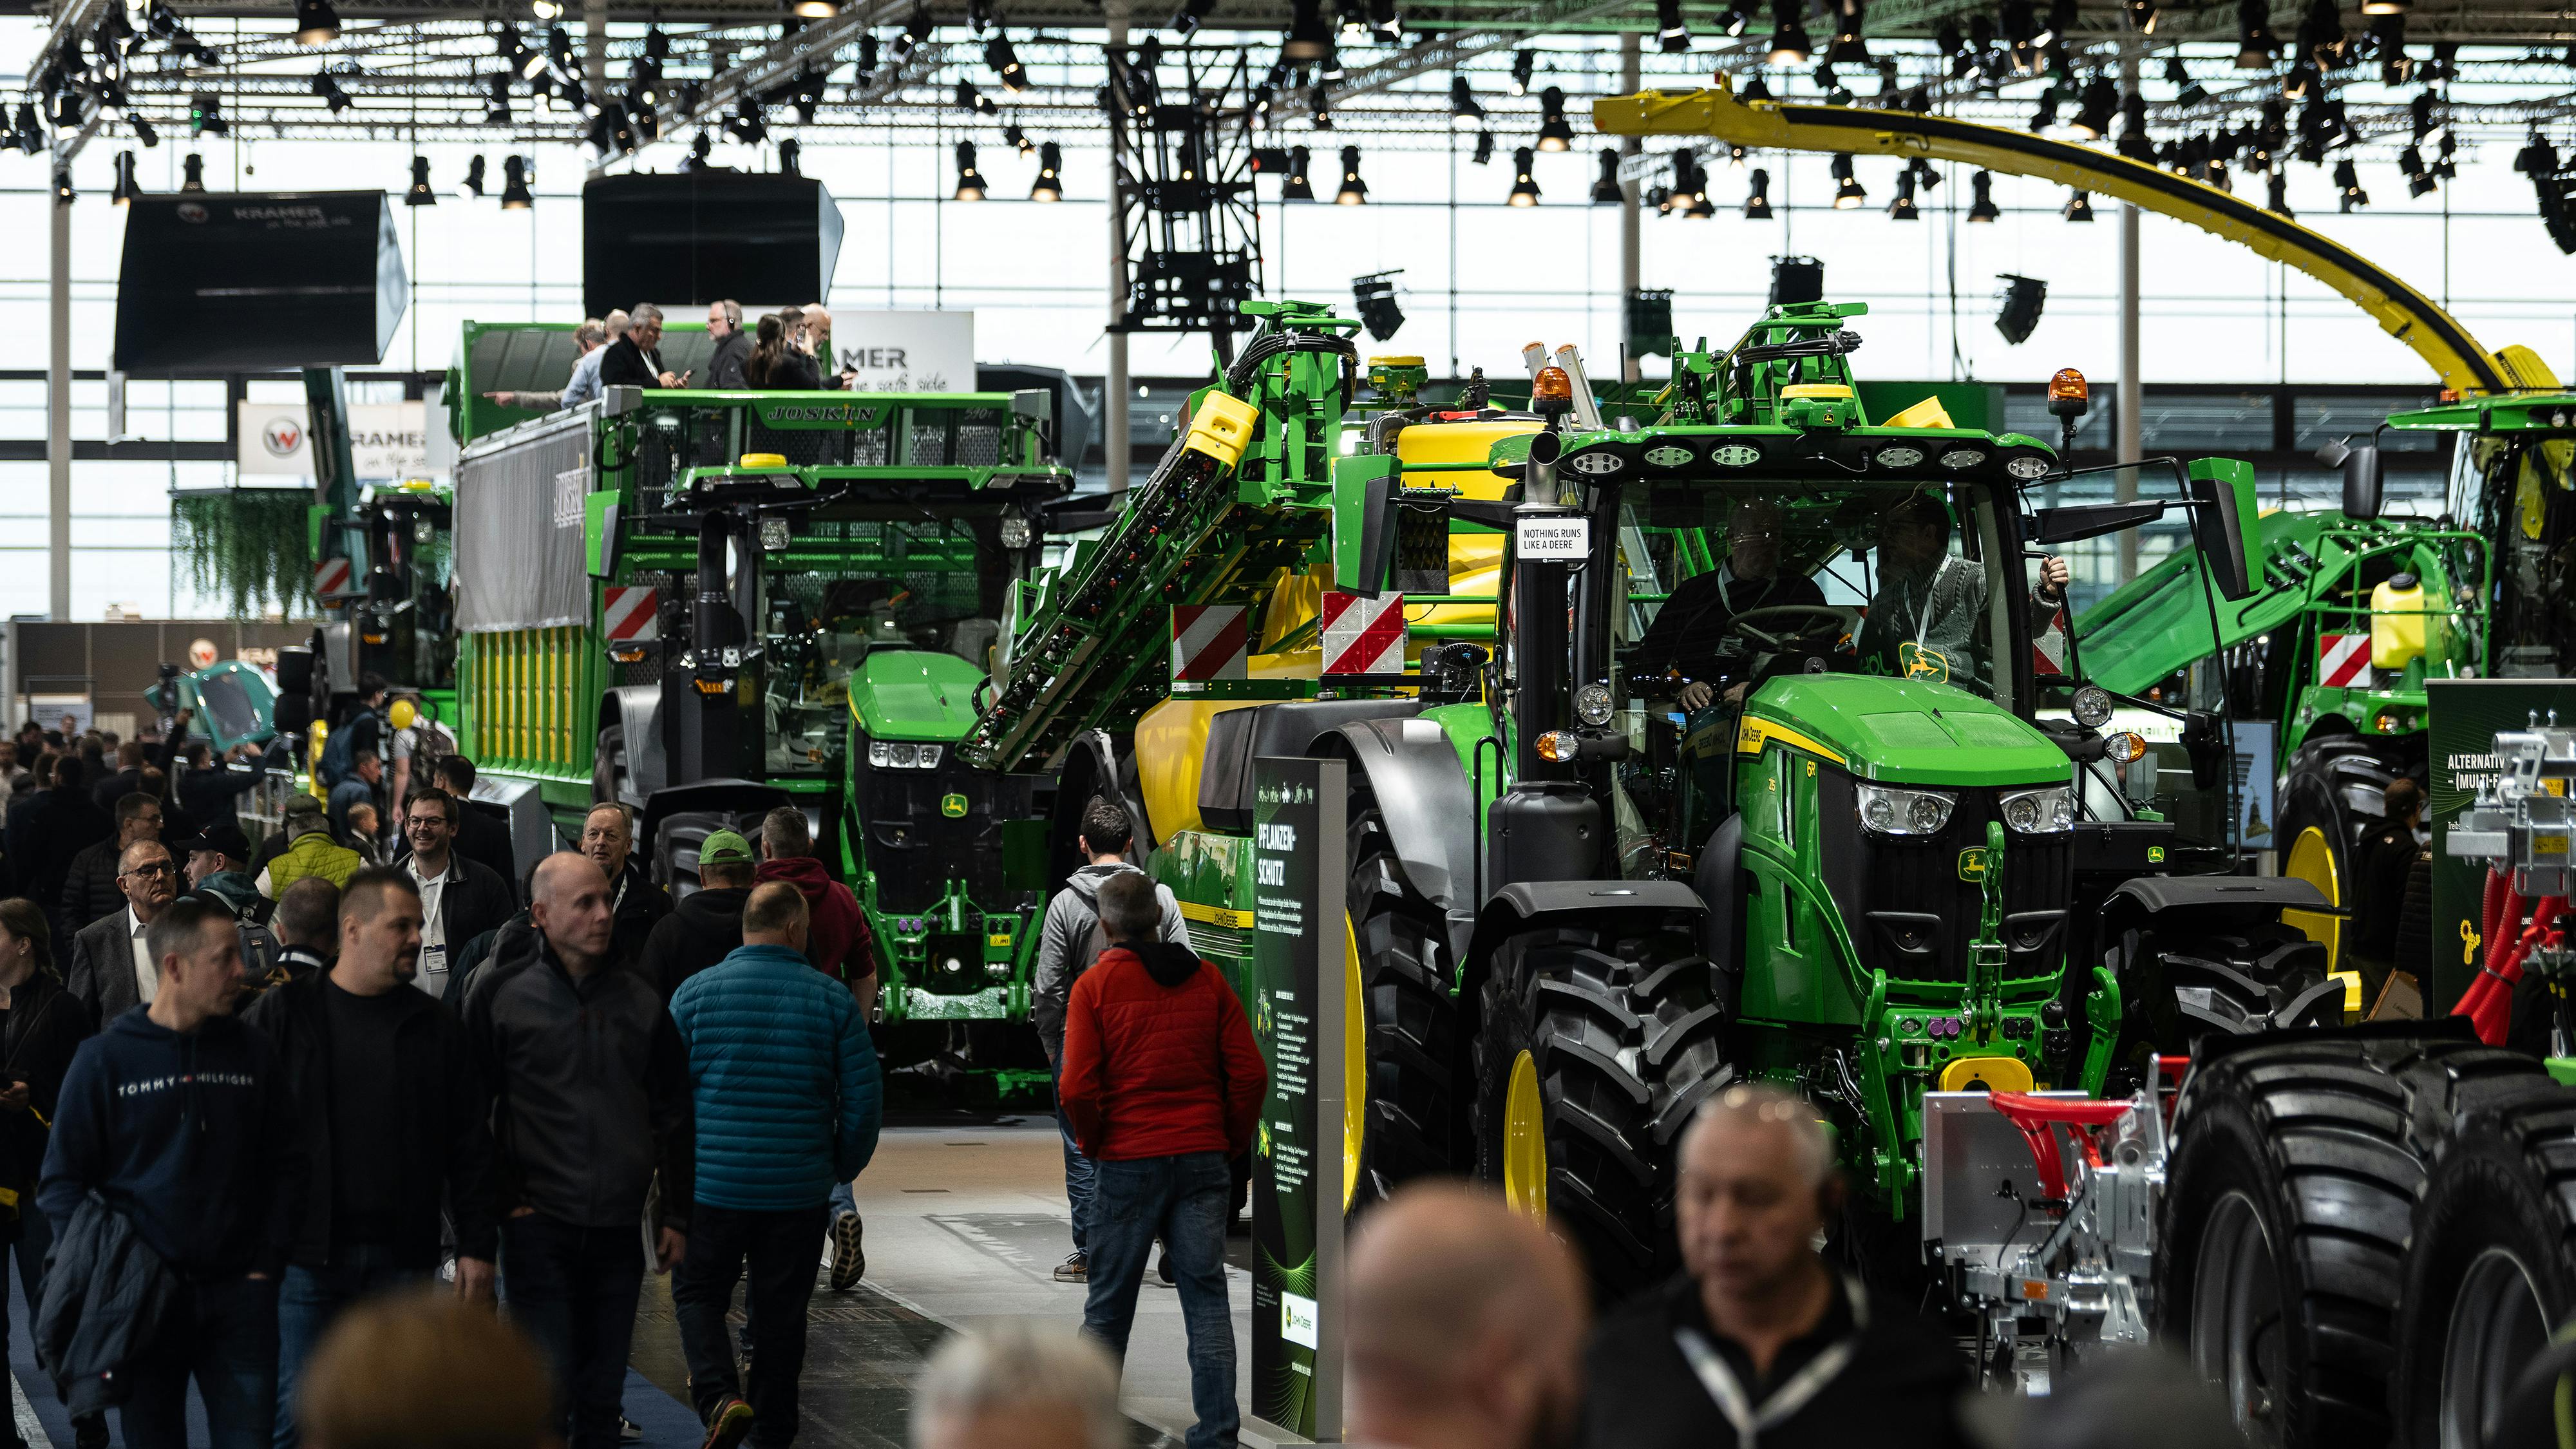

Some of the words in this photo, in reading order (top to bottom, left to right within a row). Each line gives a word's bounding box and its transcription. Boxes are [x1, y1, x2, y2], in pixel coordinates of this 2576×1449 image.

[234, 205, 322, 220] KRAMER
[768, 405, 876, 422] JOSKIN
[351, 432, 425, 447] RAME
[1524, 529, 1558, 538] NOTHING
[1561, 529, 1581, 538] RUNS
[1524, 540, 1540, 549] LIKE
[1542, 540, 1547, 549] A
[1549, 540, 1573, 549] DEERE
[1741, 726, 1750, 741] JOHN
[1750, 726, 1761, 743] DEERE
[1806, 761, 1816, 777] 6R
[2448, 754, 2505, 770] ALTERNATIV
[2456, 772, 2499, 791] (MULTI-F
[2448, 821, 2461, 831] Treibs
[1258, 824, 1297, 851] PFLANZEN-
[1258, 858, 1285, 886] SCHUTZ
[1213, 911, 1224, 927] JOHN
[1224, 913, 1238, 927] DEERE
[118, 1075, 175, 1097] TOMMY
[196, 1072, 254, 1086] HILFIGER
[1292, 1314, 1301, 1327] JOHN
[1301, 1315, 1311, 1331] DEERE
